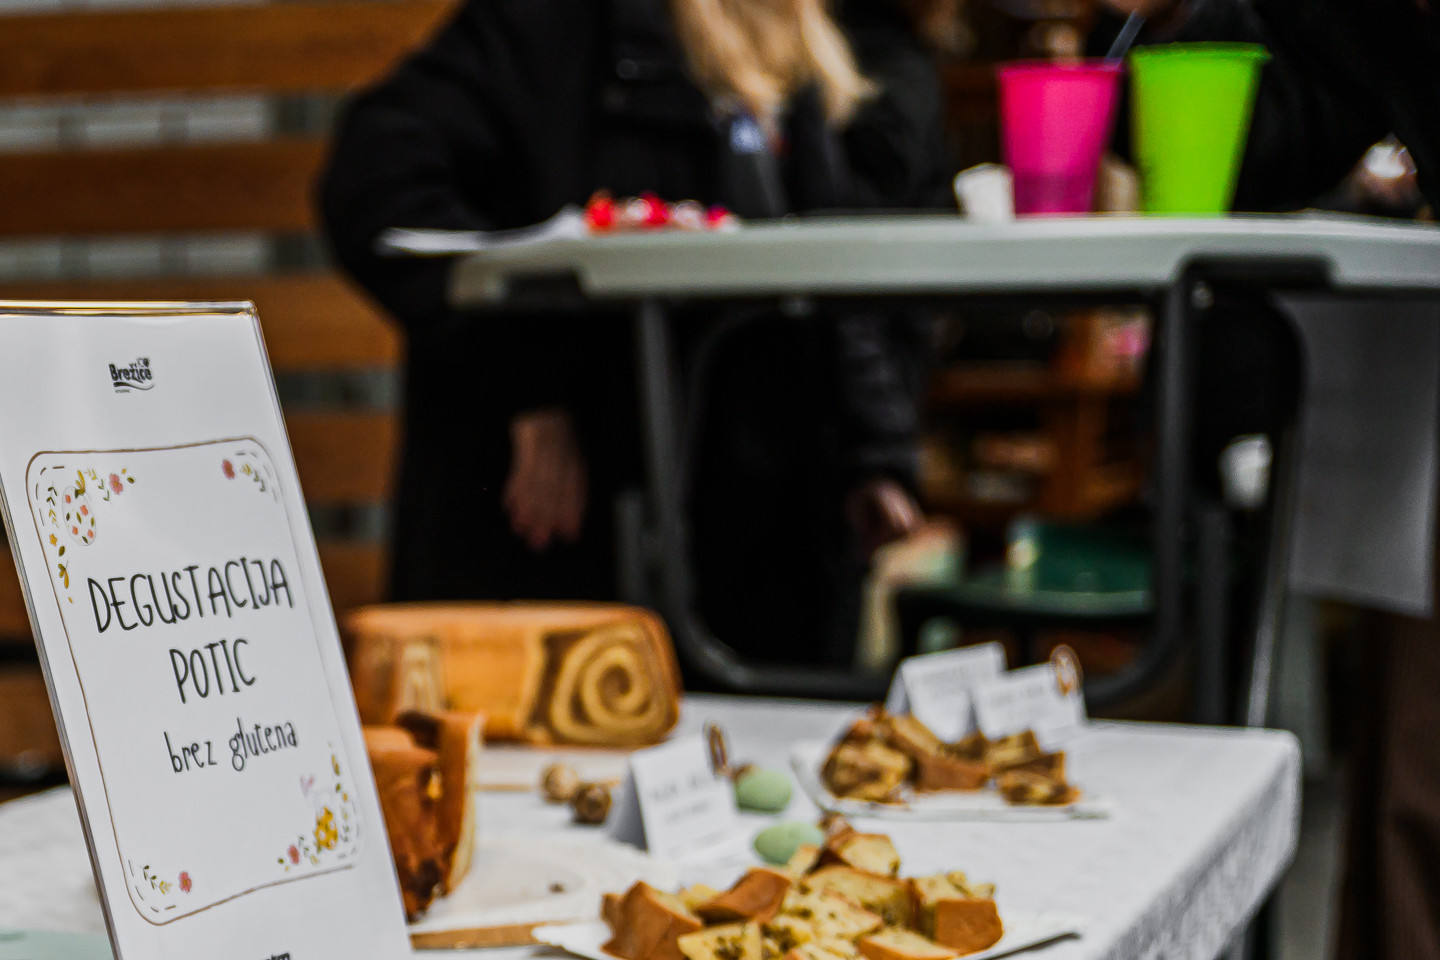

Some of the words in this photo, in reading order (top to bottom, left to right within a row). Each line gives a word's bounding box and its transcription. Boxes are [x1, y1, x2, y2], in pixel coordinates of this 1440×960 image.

[109, 362, 153, 383] Brežice
[87, 557, 294, 633] DEGUSTACIJA
[169, 638, 256, 704] POTIC
[163, 731, 218, 774] brez
[228, 717, 298, 772] glutena
